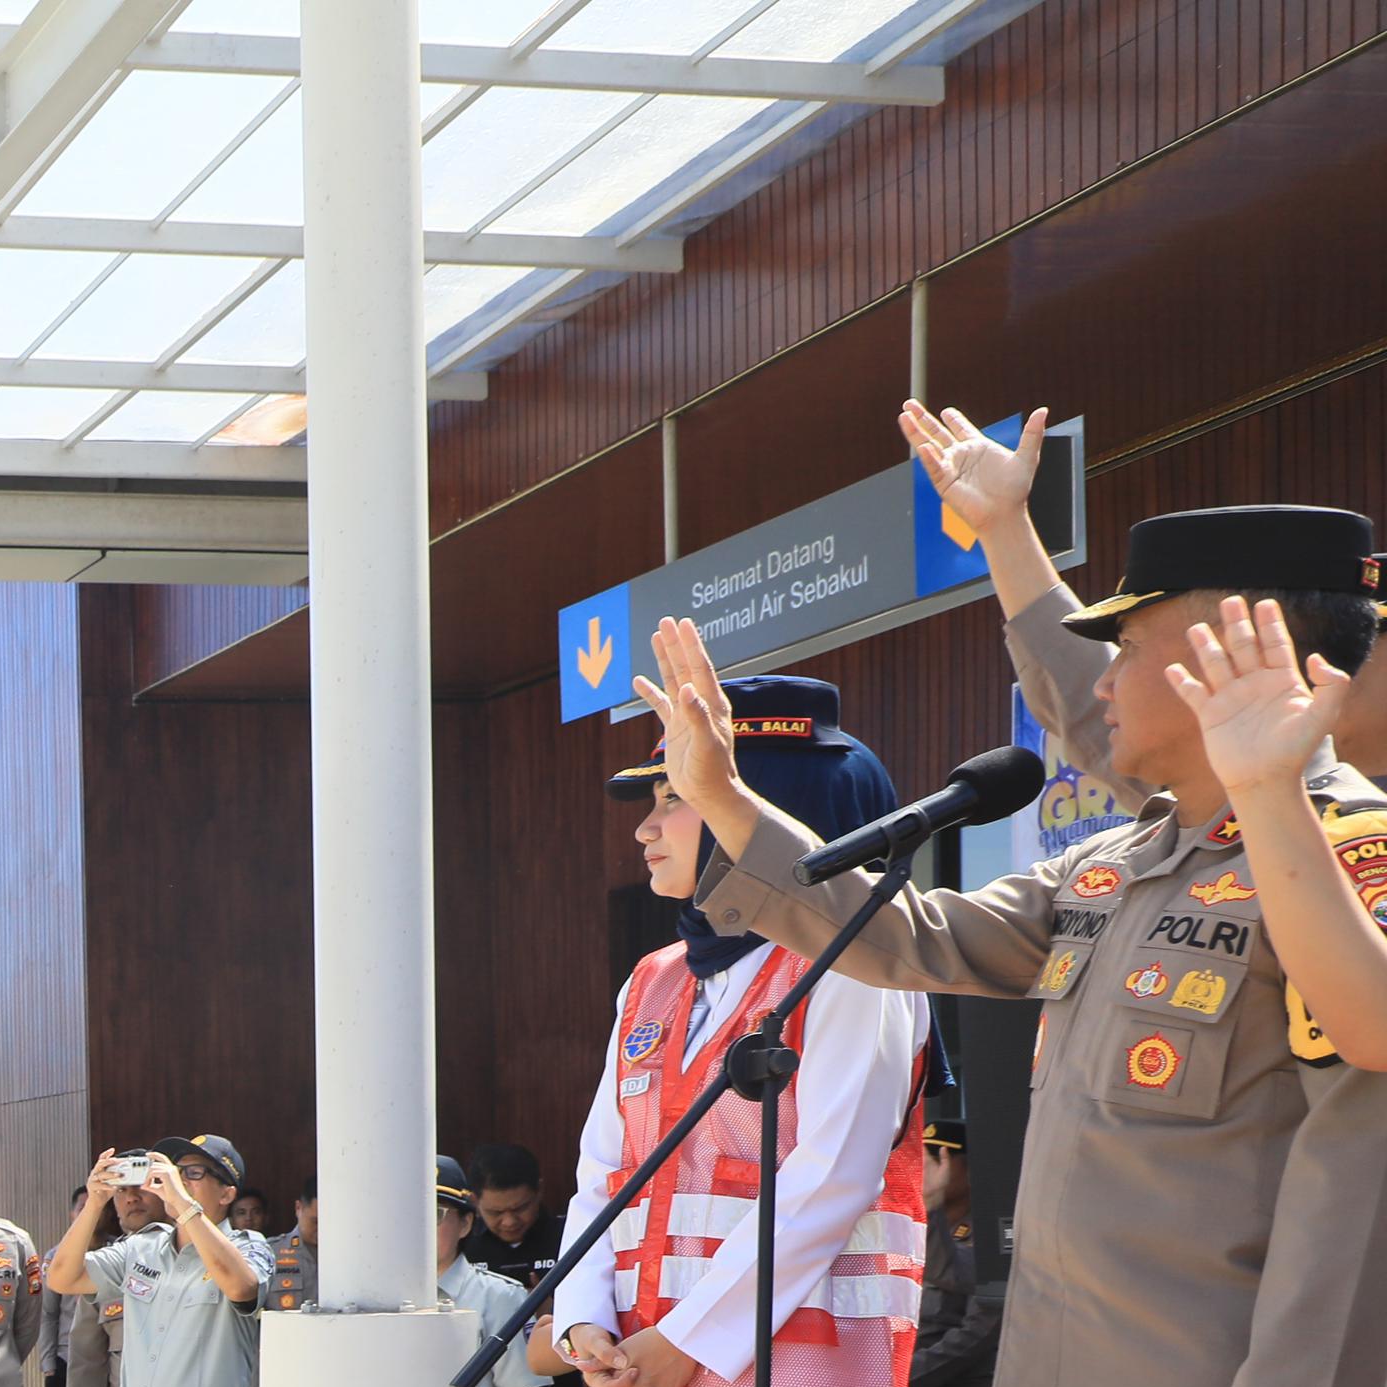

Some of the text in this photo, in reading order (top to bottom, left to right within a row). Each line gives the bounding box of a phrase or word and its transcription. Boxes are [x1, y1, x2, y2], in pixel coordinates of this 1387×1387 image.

[692, 534, 835, 609] Selamat Datang
[697, 555, 868, 642] erminal Air Sebakul
[762, 721, 806, 733] BALAI
[1147, 915, 1249, 956] POLRI
